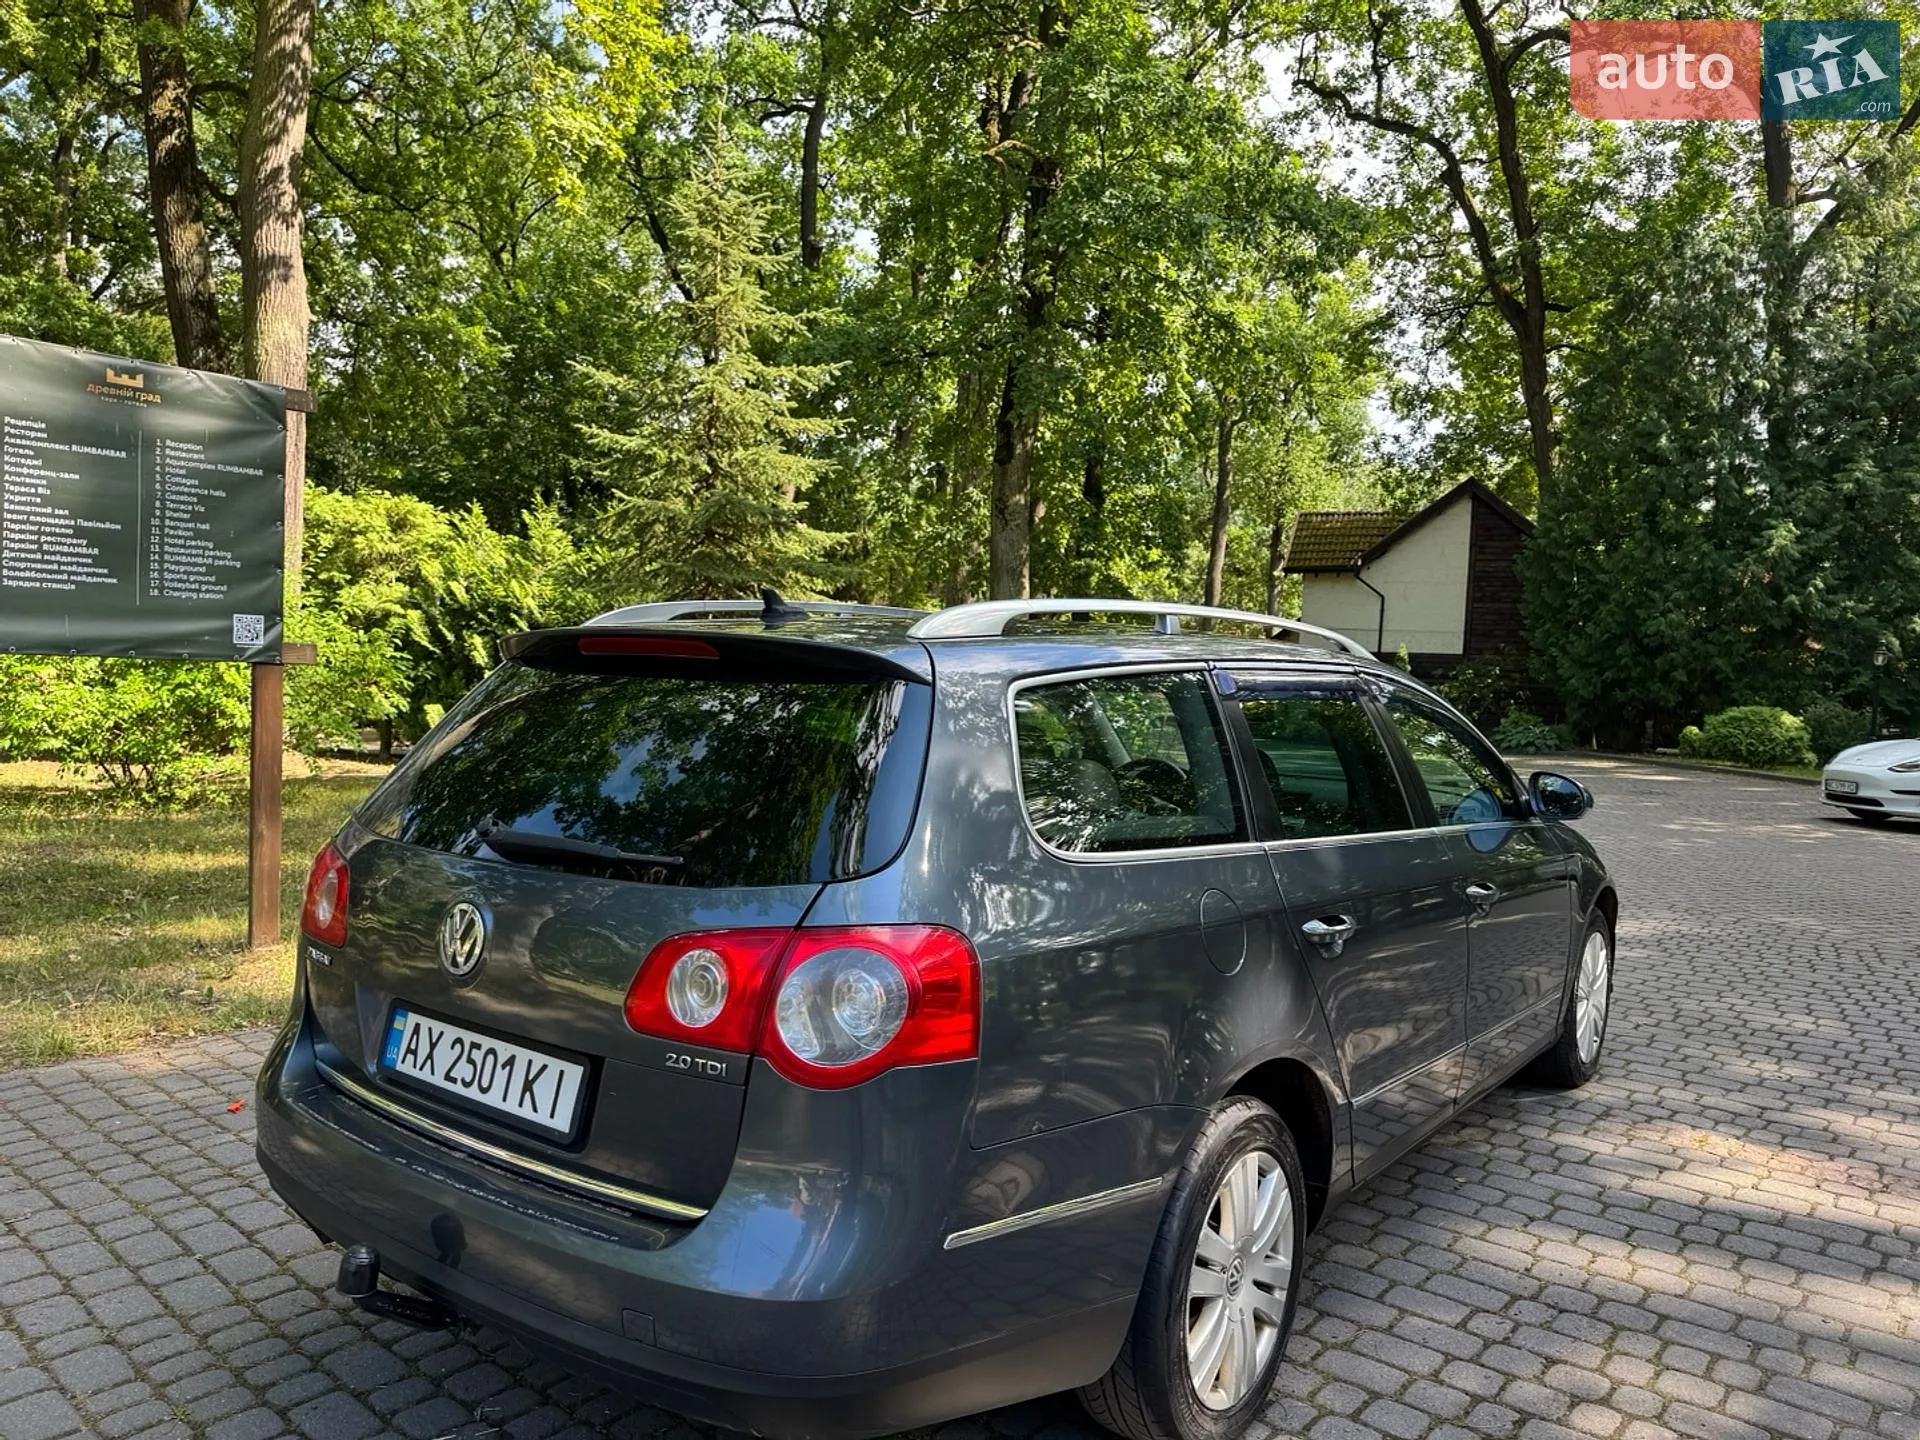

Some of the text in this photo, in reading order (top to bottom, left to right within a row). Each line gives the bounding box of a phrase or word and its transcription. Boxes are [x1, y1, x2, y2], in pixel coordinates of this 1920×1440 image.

[401, 1022, 565, 1119] AX 2501 KI
[695, 1058, 728, 1077] TDI
